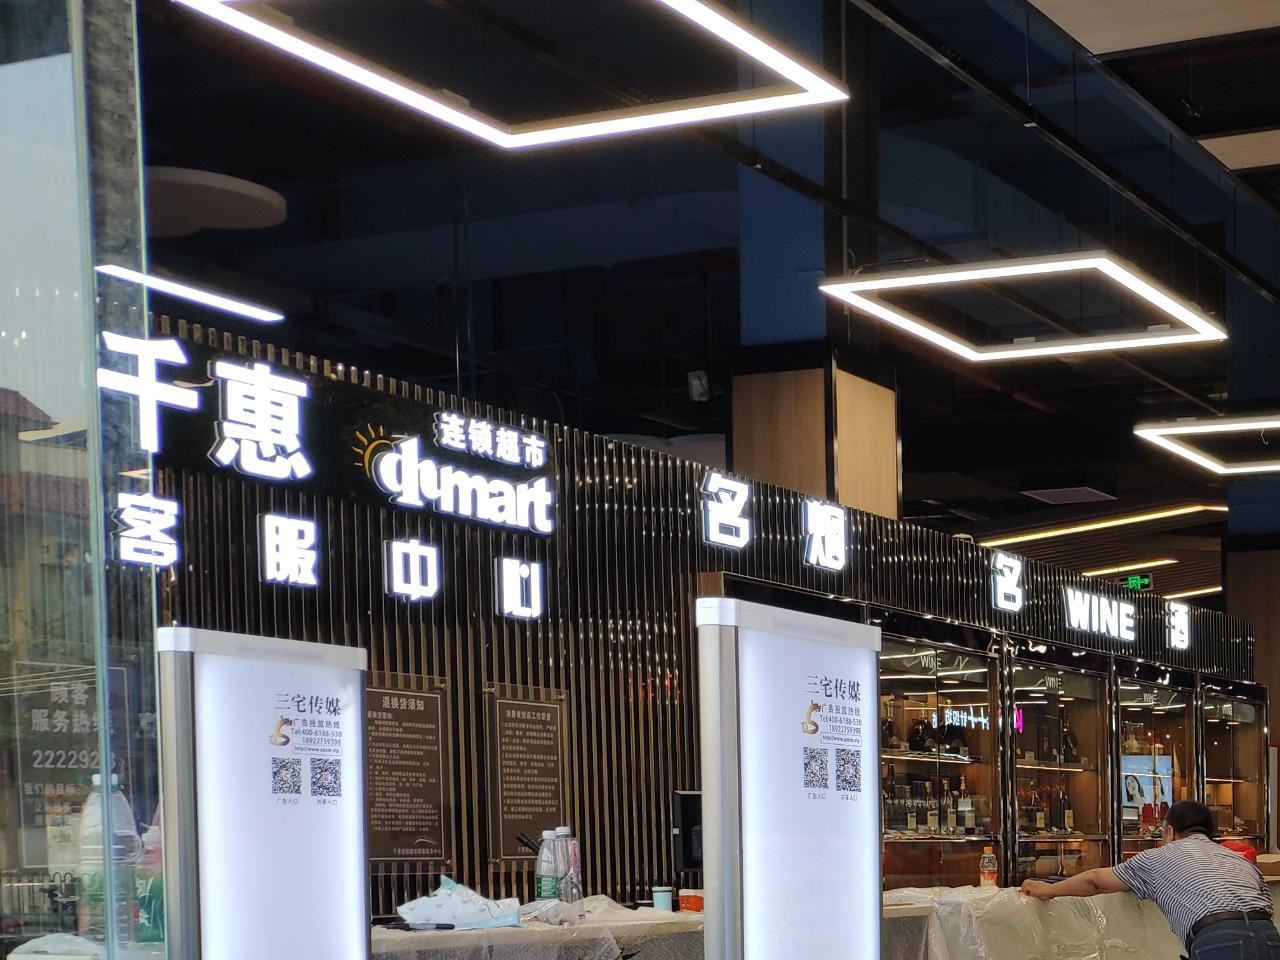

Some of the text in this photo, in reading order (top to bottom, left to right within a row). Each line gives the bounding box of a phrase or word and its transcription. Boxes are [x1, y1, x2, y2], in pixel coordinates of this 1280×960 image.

[97, 331, 312, 479] 千惠
[438, 412, 546, 468] 连锁超市
[117, 492, 543, 618] 客服中心
[996, 552, 1024, 612] 名
[1065, 587, 1135, 641] WINE
[51, 682, 90, 705] 顾客
[272, 692, 342, 717] 三宅传媒
[382, 695, 425, 711] 退换货须知
[804, 675, 861, 703] 三宅传媒
